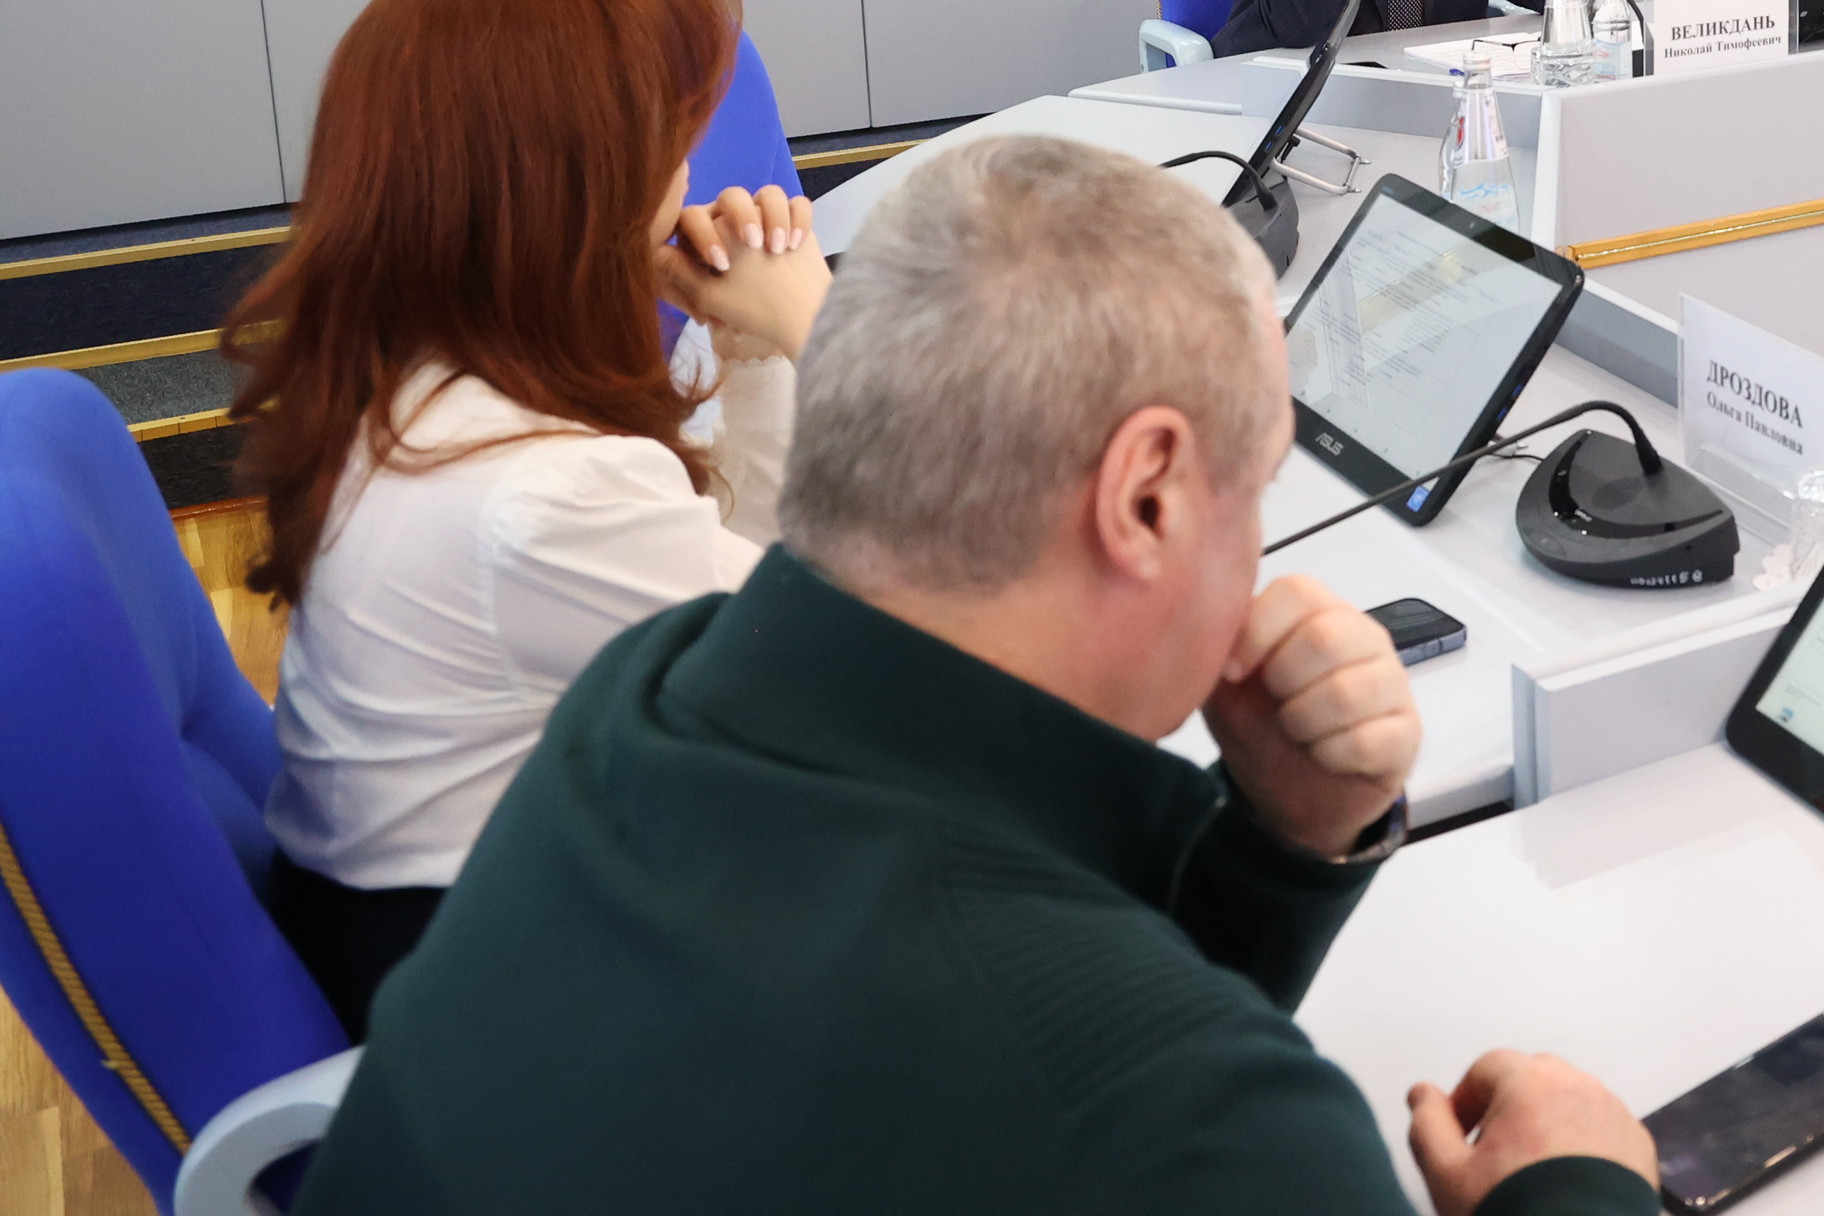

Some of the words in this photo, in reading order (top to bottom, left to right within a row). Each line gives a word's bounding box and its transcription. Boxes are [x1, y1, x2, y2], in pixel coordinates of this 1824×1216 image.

[1671, 15, 1775, 41] ВЕЛИКДАНЬ
[1664, 42, 1713, 58] Николай
[1715, 36, 1781, 52] Тимофеевич
[1706, 360, 1803, 429] ДРОЗДОВА
[1706, 391, 1742, 423] Ольга
[1745, 411, 1804, 455] Павловна
[1315, 432, 1344, 456] ASUS
